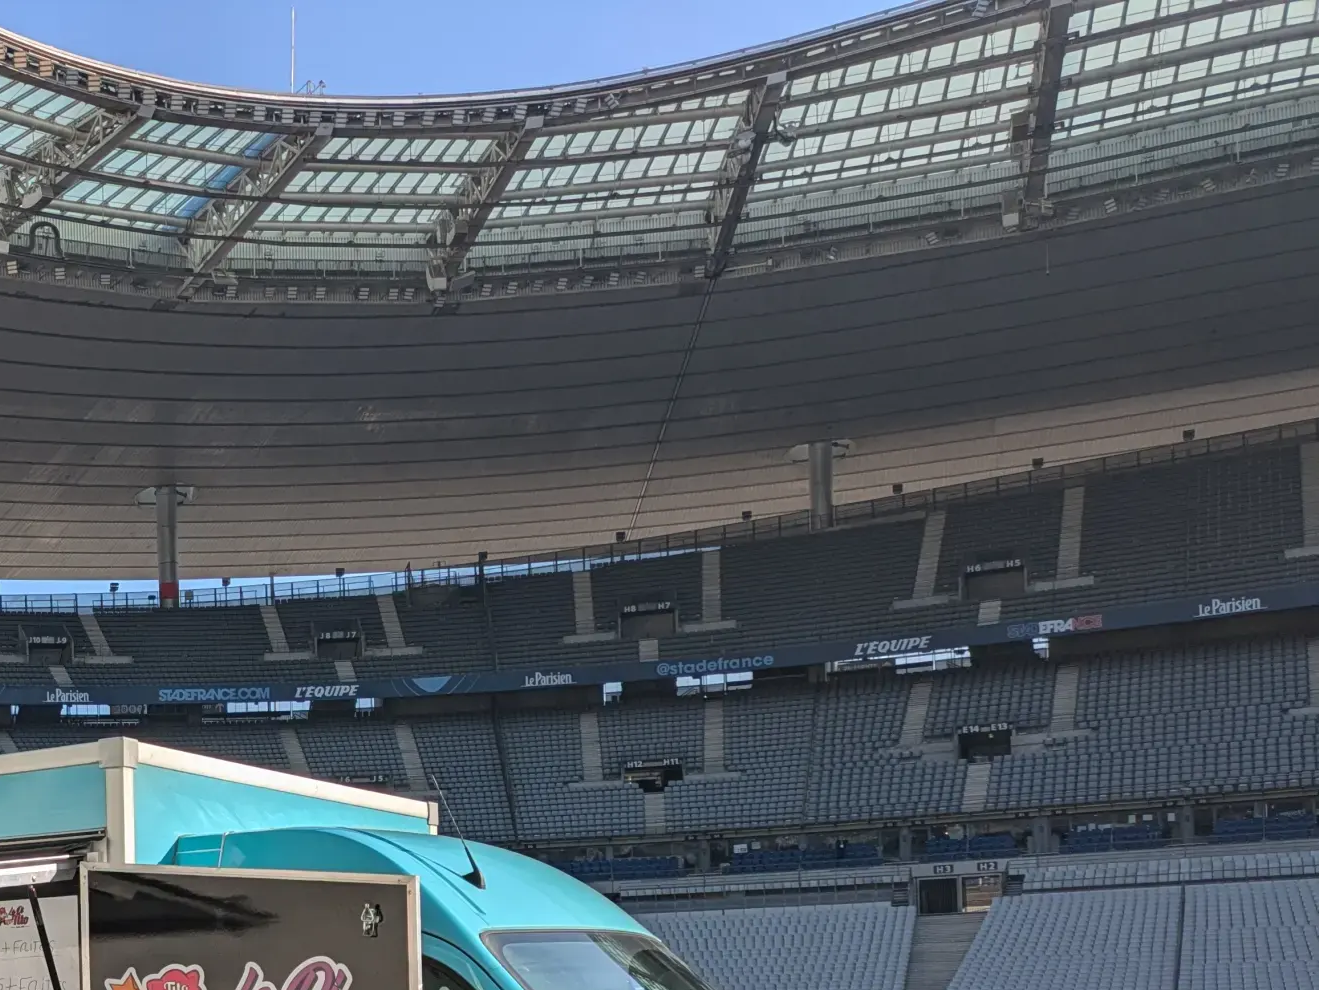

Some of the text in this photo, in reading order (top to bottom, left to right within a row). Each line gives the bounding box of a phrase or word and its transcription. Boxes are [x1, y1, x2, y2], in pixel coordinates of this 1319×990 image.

[1198, 597, 1261, 617] Le Parisien
[657, 654, 774, 677] @stadefrance
[525, 671, 572, 687] Le Parisien
[46, 688, 89, 702] Le Parisien
[158, 688, 270, 701] STADEFRANCE.COM
[13, 937, 57, 954] FRITS
